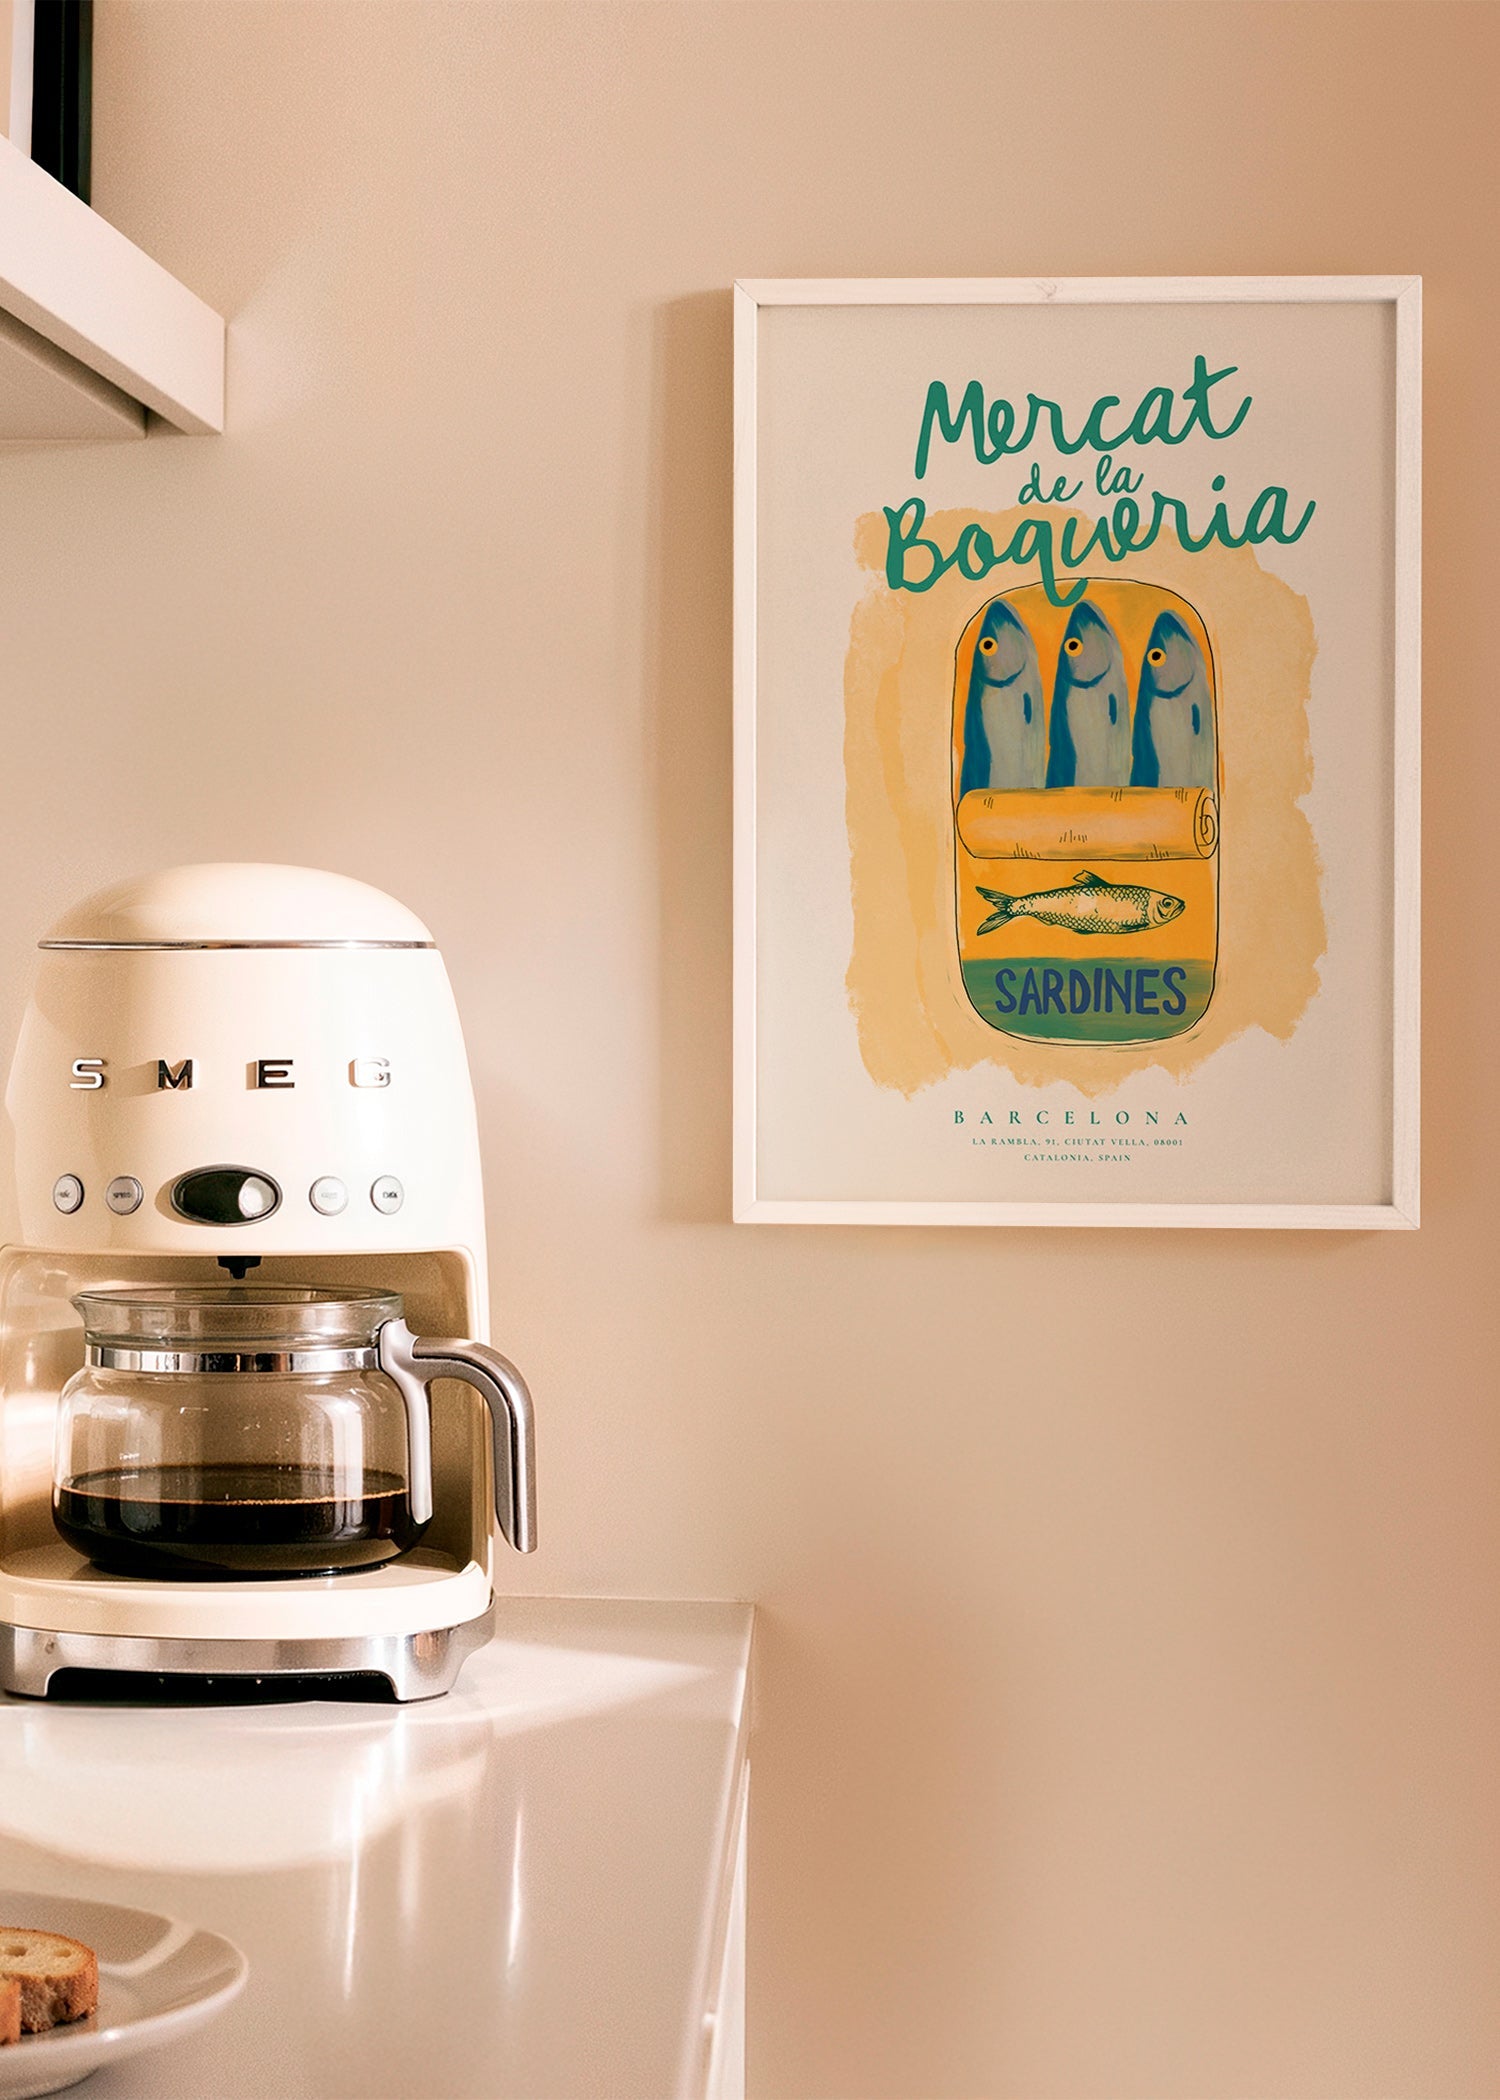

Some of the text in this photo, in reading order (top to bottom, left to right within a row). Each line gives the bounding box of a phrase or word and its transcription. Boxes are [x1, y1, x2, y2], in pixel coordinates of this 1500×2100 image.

[914, 355, 1254, 480] Mercat
[1018, 454, 1144, 505] de la
[883, 474, 1316, 608] Boqueria
[995, 966, 1187, 1016] SARDINES
[69, 1057, 392, 1089] SMEG
[953, 1110, 1188, 1125] BARCELONA
[972, 1138, 1183, 1147] LA RAMBLA, 91, CIUTAT VELLA, 08001
[1024, 1154, 1131, 1162] CATALONIA, SPAIN
